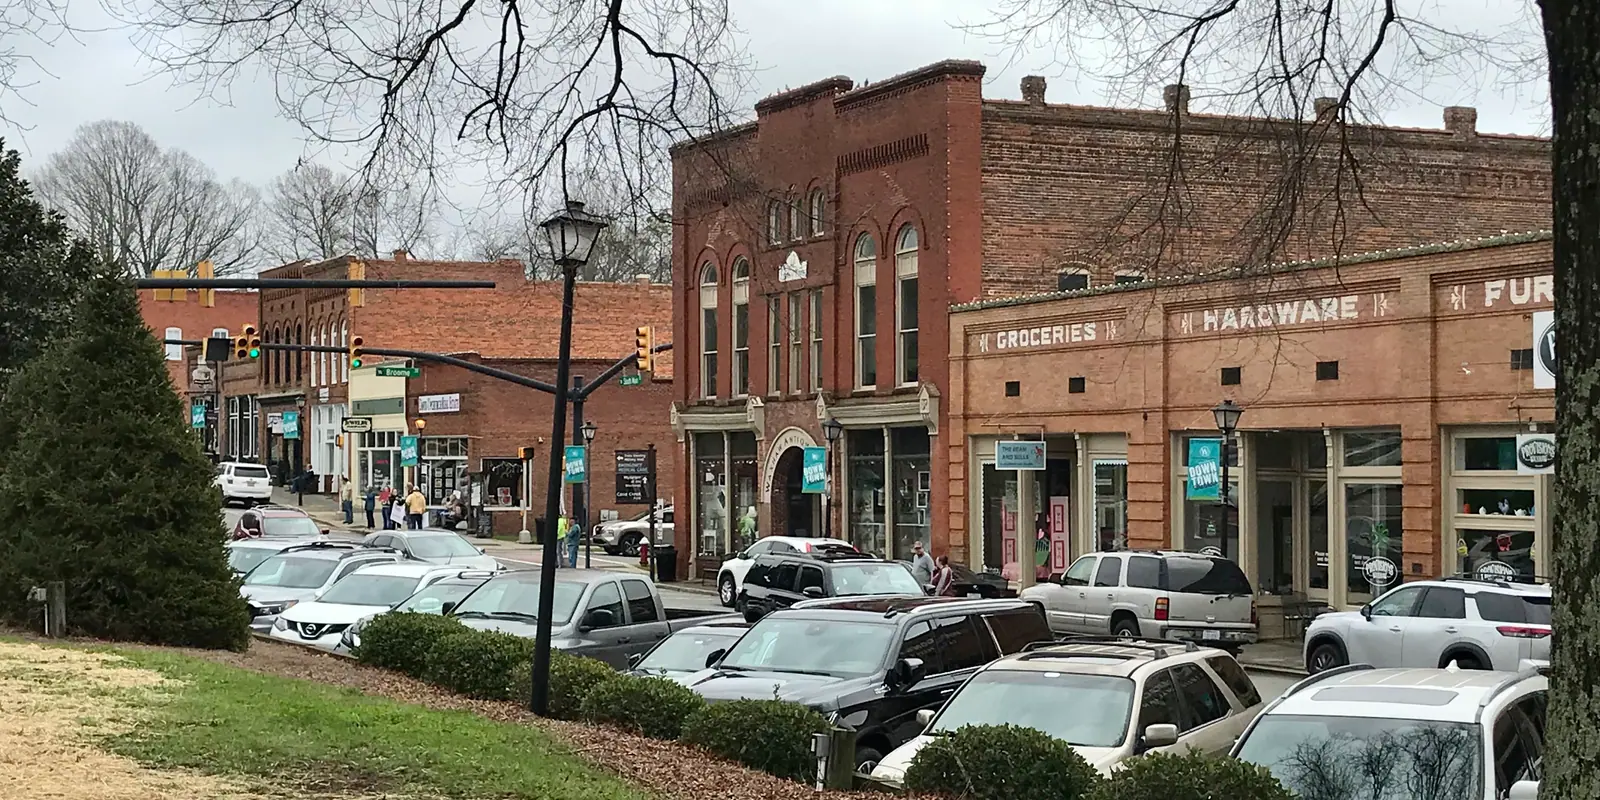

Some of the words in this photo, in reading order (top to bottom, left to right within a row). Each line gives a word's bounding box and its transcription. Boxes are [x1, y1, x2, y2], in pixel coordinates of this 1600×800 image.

[1203, 294, 1358, 332] HARDWARE
[996, 321, 1097, 349] GROCERIES
[385, 368, 411, 377] Broome
[1521, 441, 1555, 459] PROVISIONS
[804, 462, 824, 476] DOWN
[806, 471, 825, 485] TOWN
[1188, 461, 1217, 478] DOWN
[1191, 471, 1219, 489] TOWN
[1365, 558, 1394, 576] PROVISIONS
